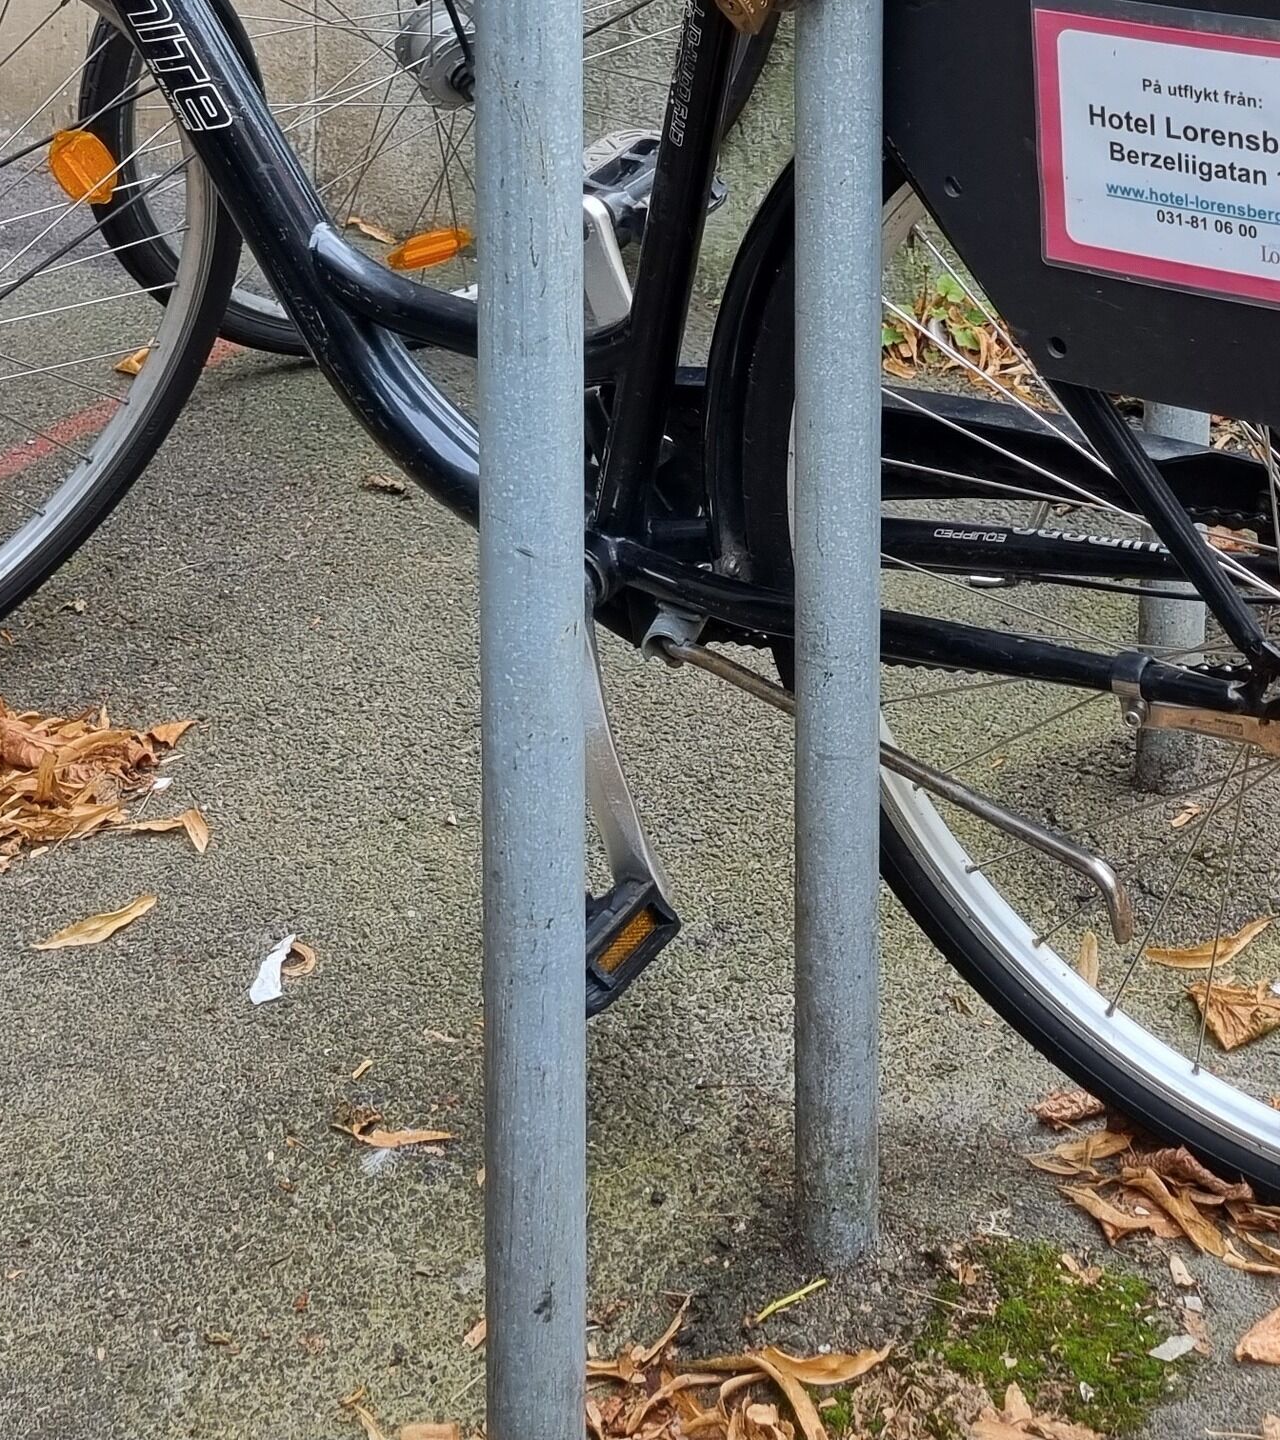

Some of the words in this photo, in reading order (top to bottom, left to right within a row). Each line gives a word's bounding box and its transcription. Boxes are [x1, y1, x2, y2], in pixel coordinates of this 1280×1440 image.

[1142, 78, 1162, 95] På
[1167, 83, 1219, 104] utflykt
[1223, 90, 1262, 109] från:
[1088, 103, 1156, 136] Hotel
[1109, 140, 1268, 187] Berzeliigatan
[1156, 209, 1208, 231] 031-81
[1214, 219, 1234, 235] 06
[1238, 223, 1258, 239] 00
[933, 527, 1008, 544] EQUIPPED
